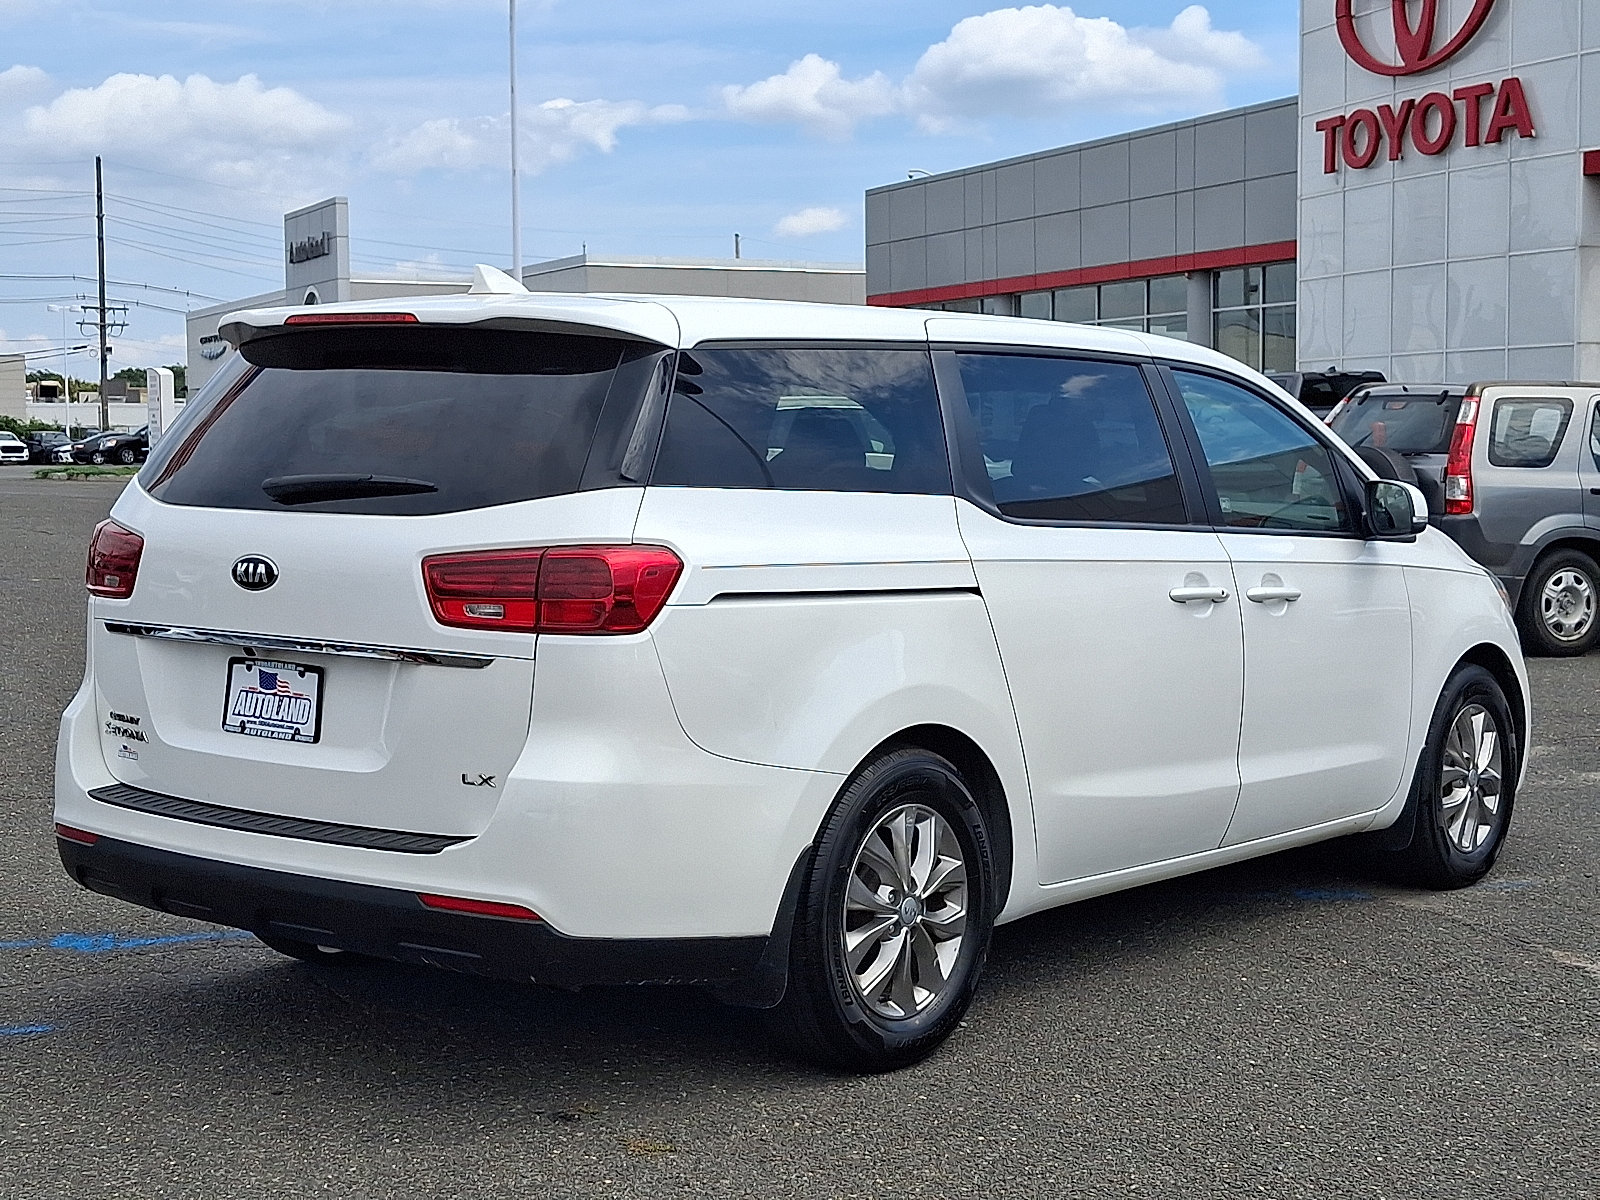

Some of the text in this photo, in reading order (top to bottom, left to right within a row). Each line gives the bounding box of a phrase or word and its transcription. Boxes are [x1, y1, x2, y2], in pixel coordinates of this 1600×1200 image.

[1315, 77, 1536, 174] TOYOTA
[236, 562, 268, 583] KIA
[233, 690, 312, 724] AUTOLAND
[244, 727, 292, 741] AUTOLAND
[461, 773, 497, 788] LX
